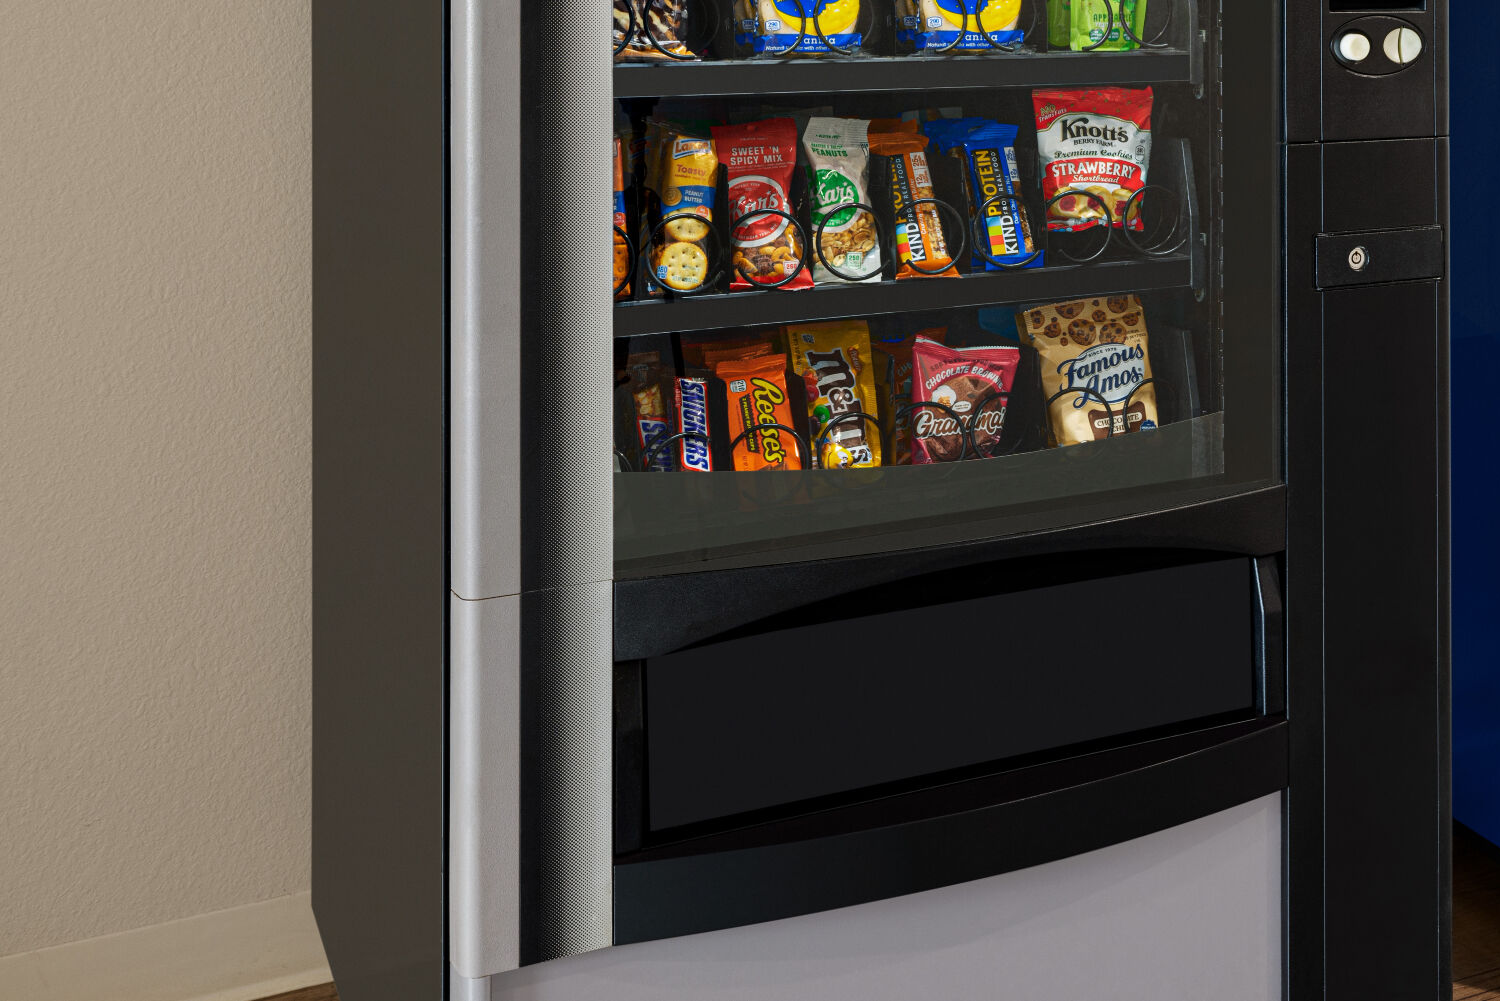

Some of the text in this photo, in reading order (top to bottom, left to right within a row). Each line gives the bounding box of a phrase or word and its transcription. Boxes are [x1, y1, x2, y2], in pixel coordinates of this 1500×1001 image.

[1061, 117, 1129, 143] Knott's
[731, 146, 765, 156] SWEET
[1073, 138, 1094, 146] BERRY
[730, 155, 762, 166] SPICY
[763, 153, 783, 163] MIX
[811, 147, 848, 158] PEANUTS
[1054, 148, 1133, 160] Premium Cookies
[895, 158, 909, 199] REAL FOOD
[990, 151, 1004, 192] REAL FOOD
[1051, 161, 1136, 179] STRAWBERRY
[1072, 174, 1120, 183] Shortbread
[684, 189, 704, 197] PEANUT
[684, 196, 703, 204] BUTTER
[905, 222, 926, 261] KIND
[1000, 215, 1019, 254] KIND
[1057, 344, 1144, 390] Famous
[925, 366, 970, 390] CHOCOLATE
[1073, 367, 1143, 409] Amos
[681, 378, 709, 471] SNICKERS
[750, 377, 787, 463] Reese's
[1097, 413, 1139, 427] CHOCOATE
[1112, 424, 1125, 433] CHI
